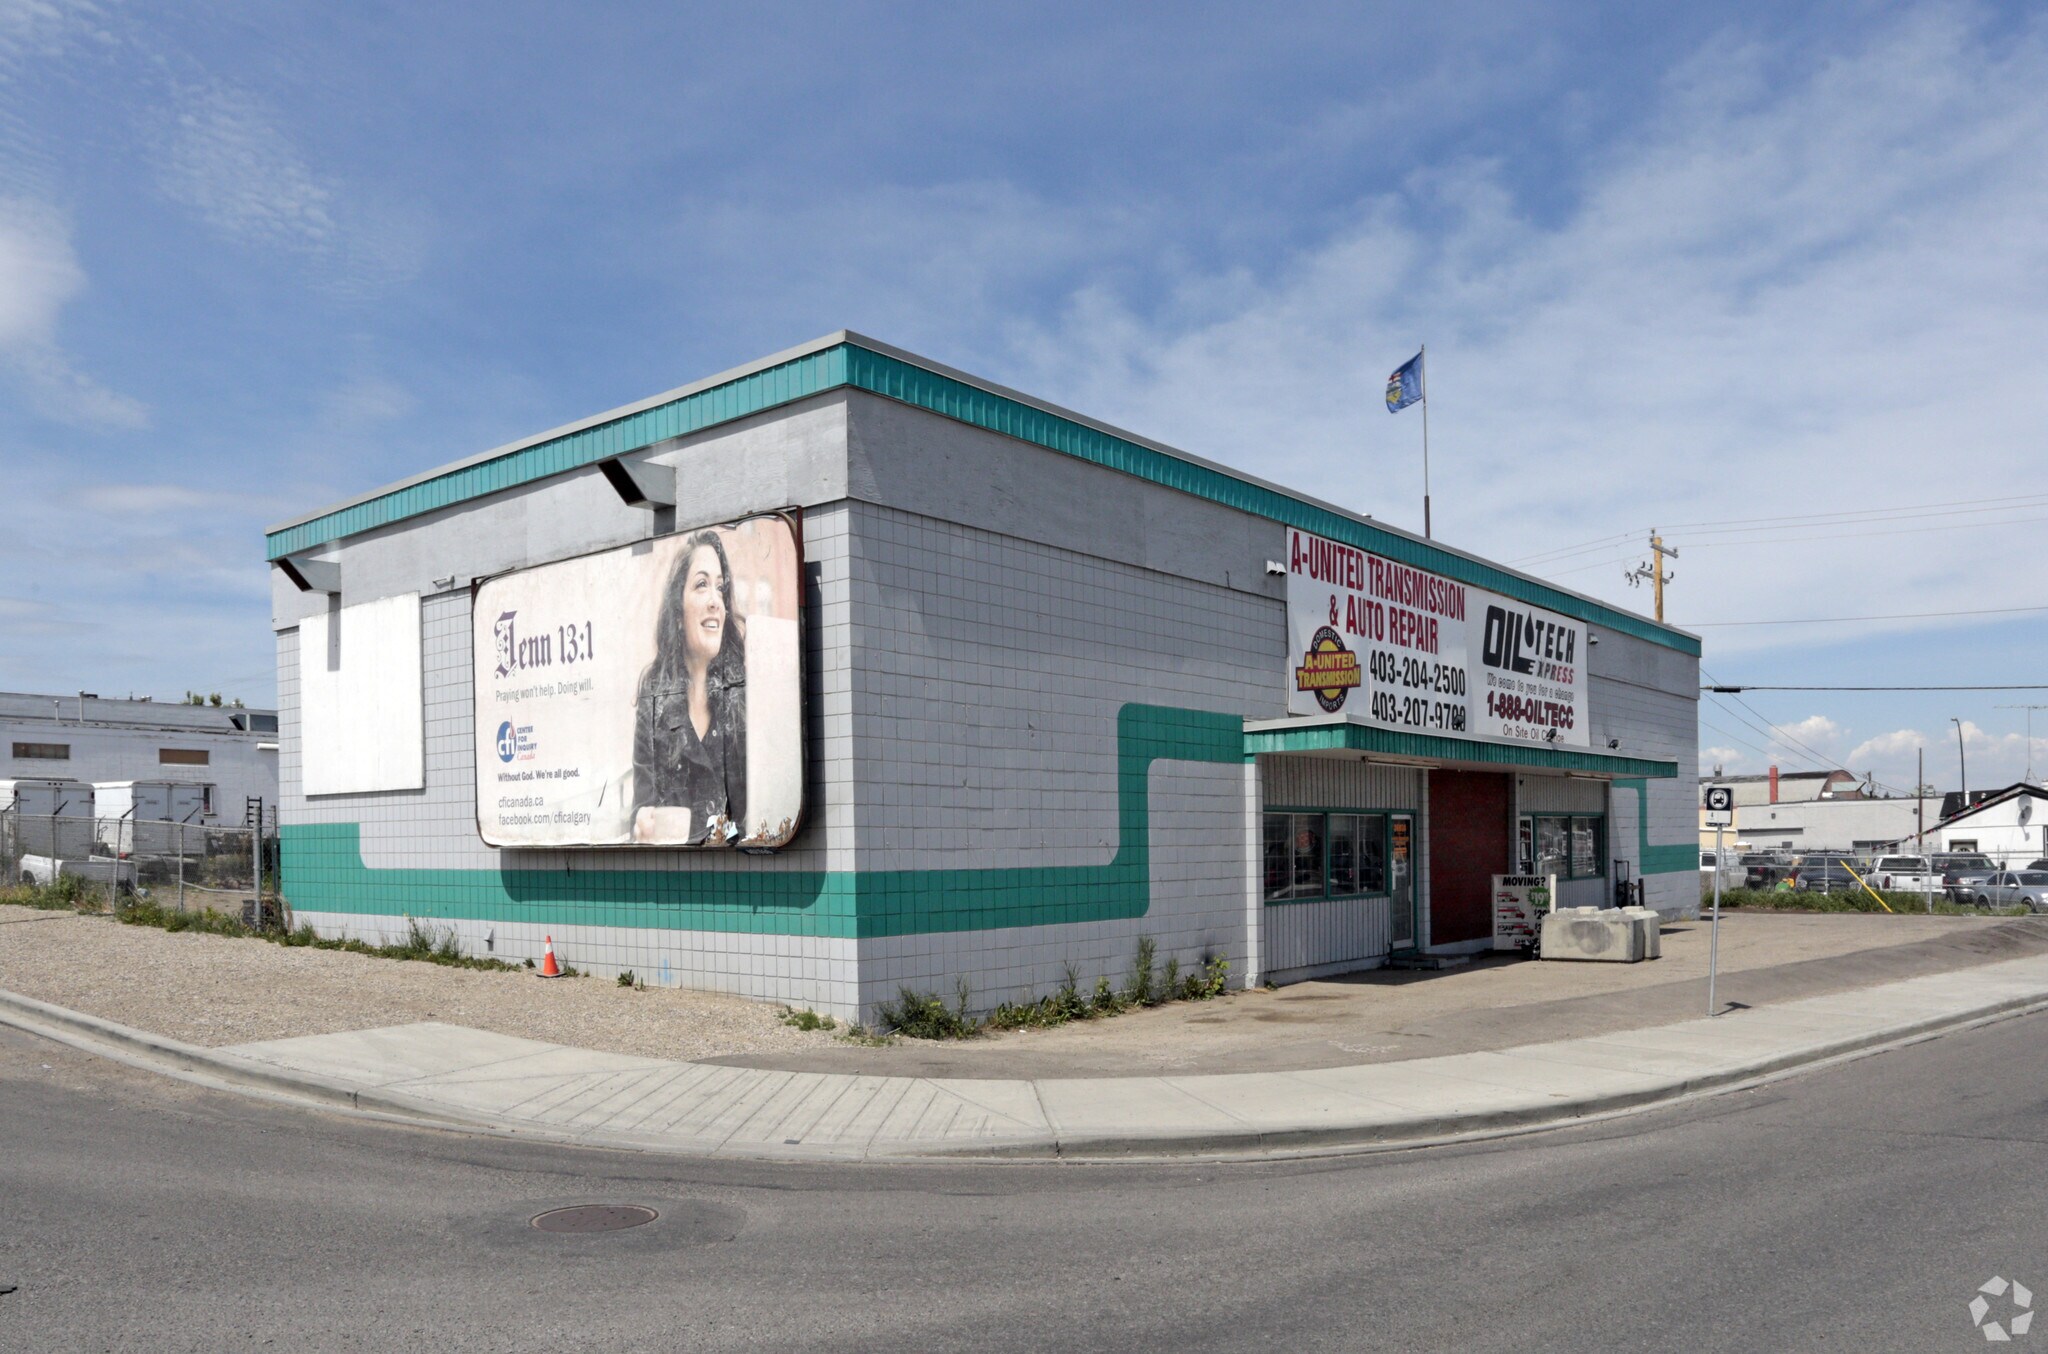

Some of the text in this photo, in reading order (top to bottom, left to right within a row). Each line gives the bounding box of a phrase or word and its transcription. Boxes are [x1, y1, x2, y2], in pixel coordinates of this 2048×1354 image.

[1291, 531, 1465, 622] A-UNITED TRANSMISSION
[1329, 594, 1438, 655] & AUTO REPAIR
[494, 610, 593, 680] Jenn 13:1
[1312, 628, 1342, 650] DOMESTIC
[1482, 604, 1575, 675] OIL TECH
[1305, 653, 1356, 670] A-UNITED
[1297, 667, 1361, 688] TRANSMISSION
[1370, 649, 1466, 697] 403-204-2500
[495, 677, 594, 704] Praying won't help. Doing will.
[1525, 682, 1537, 696] you
[1538, 683, 1549, 696] for
[1319, 693, 1345, 711] IMPORTS
[1487, 690, 1574, 730] 1-888-OILTECC
[498, 727, 515, 756] cfi
[517, 735, 528, 743] FOR
[1502, 723, 1513, 736] On
[1515, 725, 1529, 739] Site
[1530, 727, 1540, 741] Oil
[497, 767, 580, 782] Without God. We're all good.
[498, 795, 544, 809] cficanada.ca
[498, 810, 592, 827] facebook.com/cficalgary
[1502, 876, 1546, 887] MOVING?
